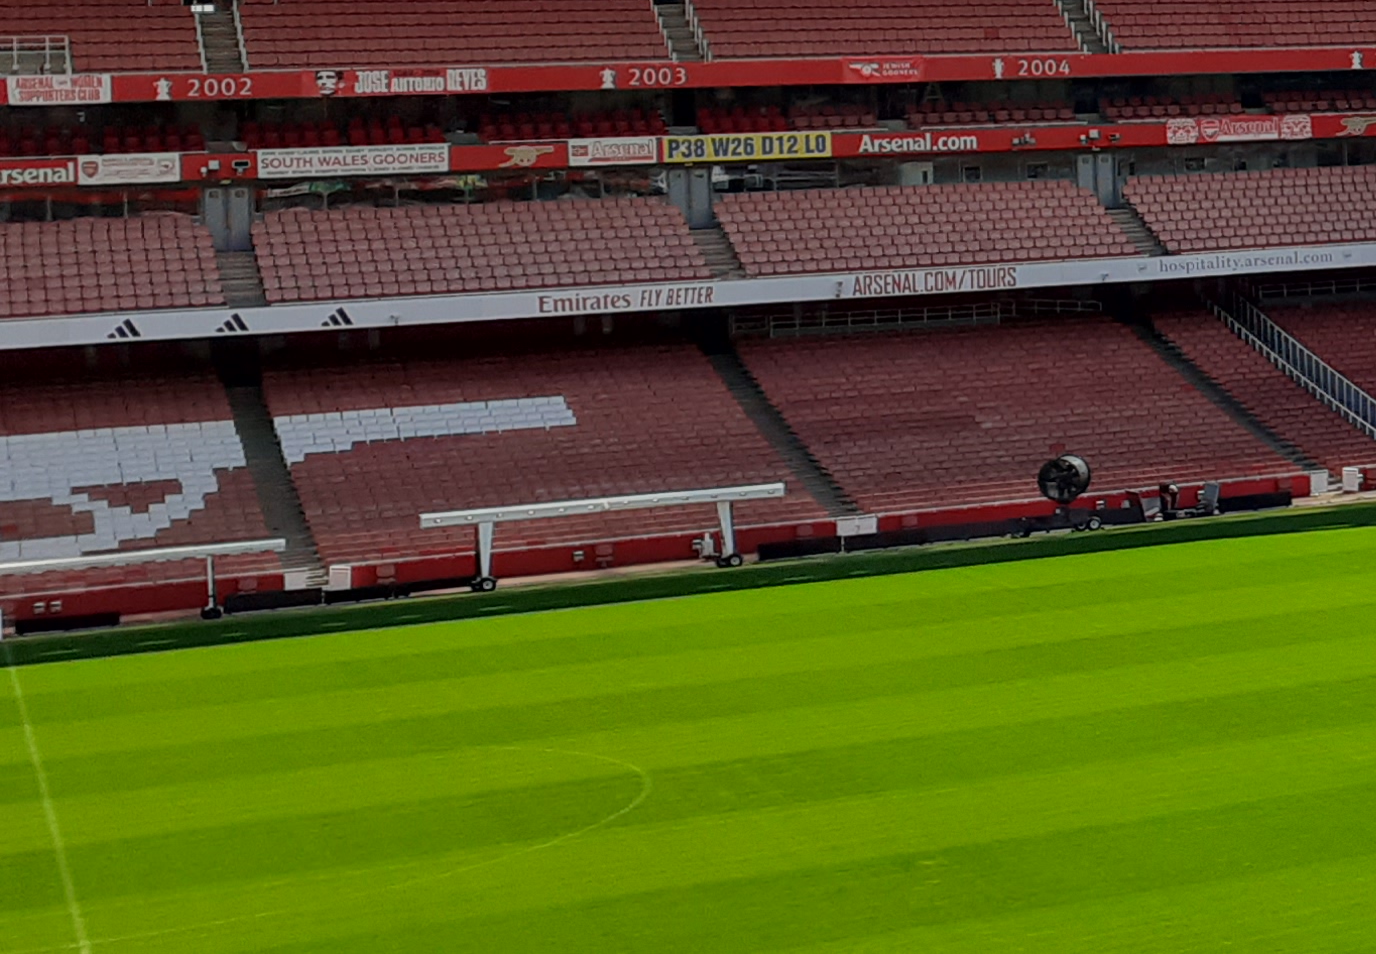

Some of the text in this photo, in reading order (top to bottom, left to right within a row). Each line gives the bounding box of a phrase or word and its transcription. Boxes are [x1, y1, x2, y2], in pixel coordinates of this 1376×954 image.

[629, 68, 686, 85] 2003
[1018, 60, 1070, 75] 2004
[188, 78, 252, 97] 2002
[355, 71, 388, 93] JOSE
[668, 138, 705, 158] P38
[711, 137, 755, 156] W26
[762, 135, 799, 155] D12
[859, 133, 977, 153] Arsenal.com
[261, 152, 445, 170] SOUTH WALES GOONERS
[1160, 252, 1332, 274] hospitality.arsenal.com
[853, 267, 1017, 296] ARSENAL.COM/TOURS
[538, 286, 714, 314] Emirates FLY BETTER
